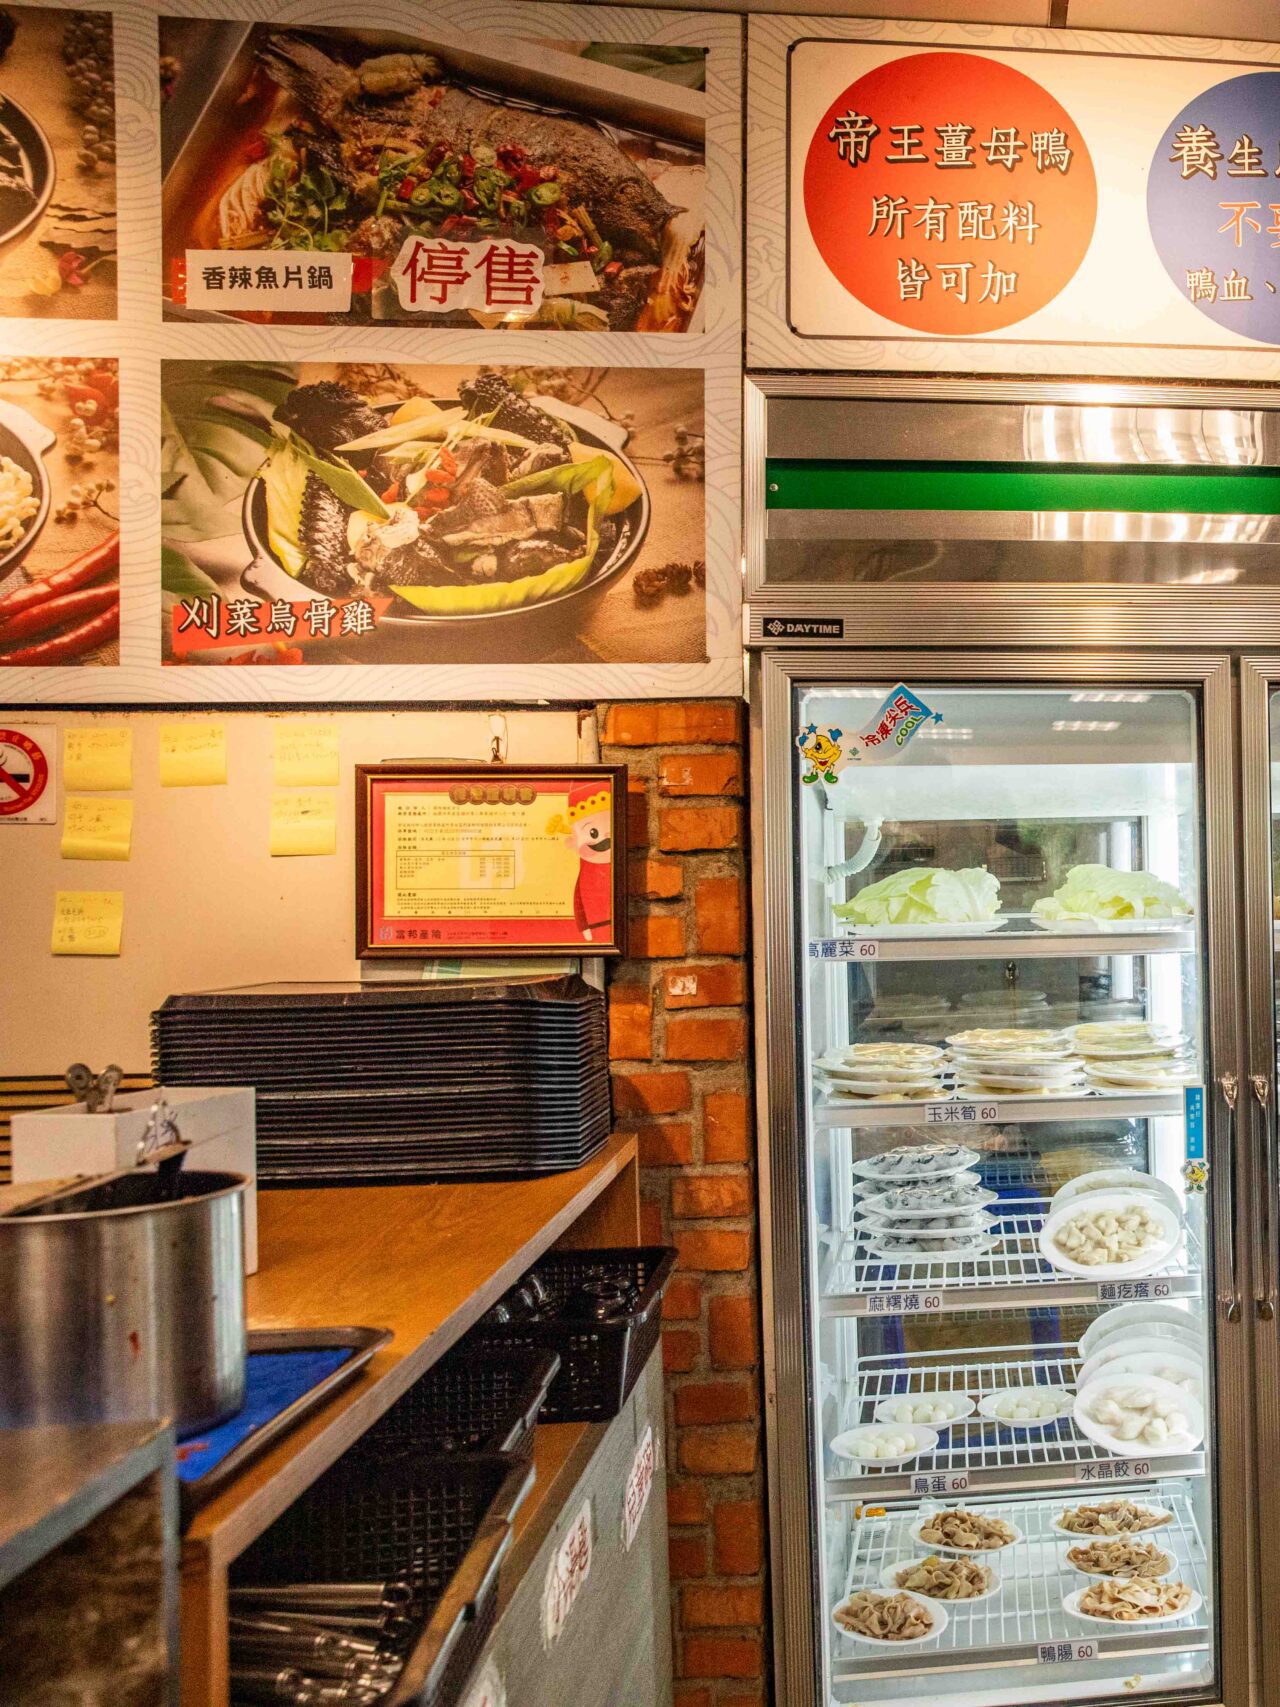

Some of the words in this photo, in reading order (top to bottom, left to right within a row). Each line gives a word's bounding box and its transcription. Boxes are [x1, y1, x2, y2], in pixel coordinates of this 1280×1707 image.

[829, 109, 1073, 173] 帝王薑母鴨
[867, 195, 1041, 245] 所有配料
[201, 263, 335, 292] 香辣魚片鍋
[401, 240, 542, 308] 停售
[895, 258, 1018, 304] 皆可加
[178, 595, 377, 638] 刈菜烏骨雞
[786, 623, 840, 634] DAYTIME
[895, 715, 923, 746] COOL
[860, 943, 876, 956] 60
[927, 1105, 976, 1123] 玉米筍
[981, 1107, 997, 1119] 60
[1100, 1281, 1149, 1301] 麵疙瘩
[1154, 1284, 1169, 1297] 60
[868, 1294, 920, 1312] 麻糬燒
[924, 1296, 940, 1309] 60
[1080, 1462, 1130, 1481] 水晶餃
[1134, 1463, 1150, 1476] 60
[913, 1476, 947, 1494] 鳥蛋
[951, 1477, 967, 1490] 60
[1040, 1643, 1073, 1663] 鴨腸
[1077, 1645, 1093, 1658] 60
